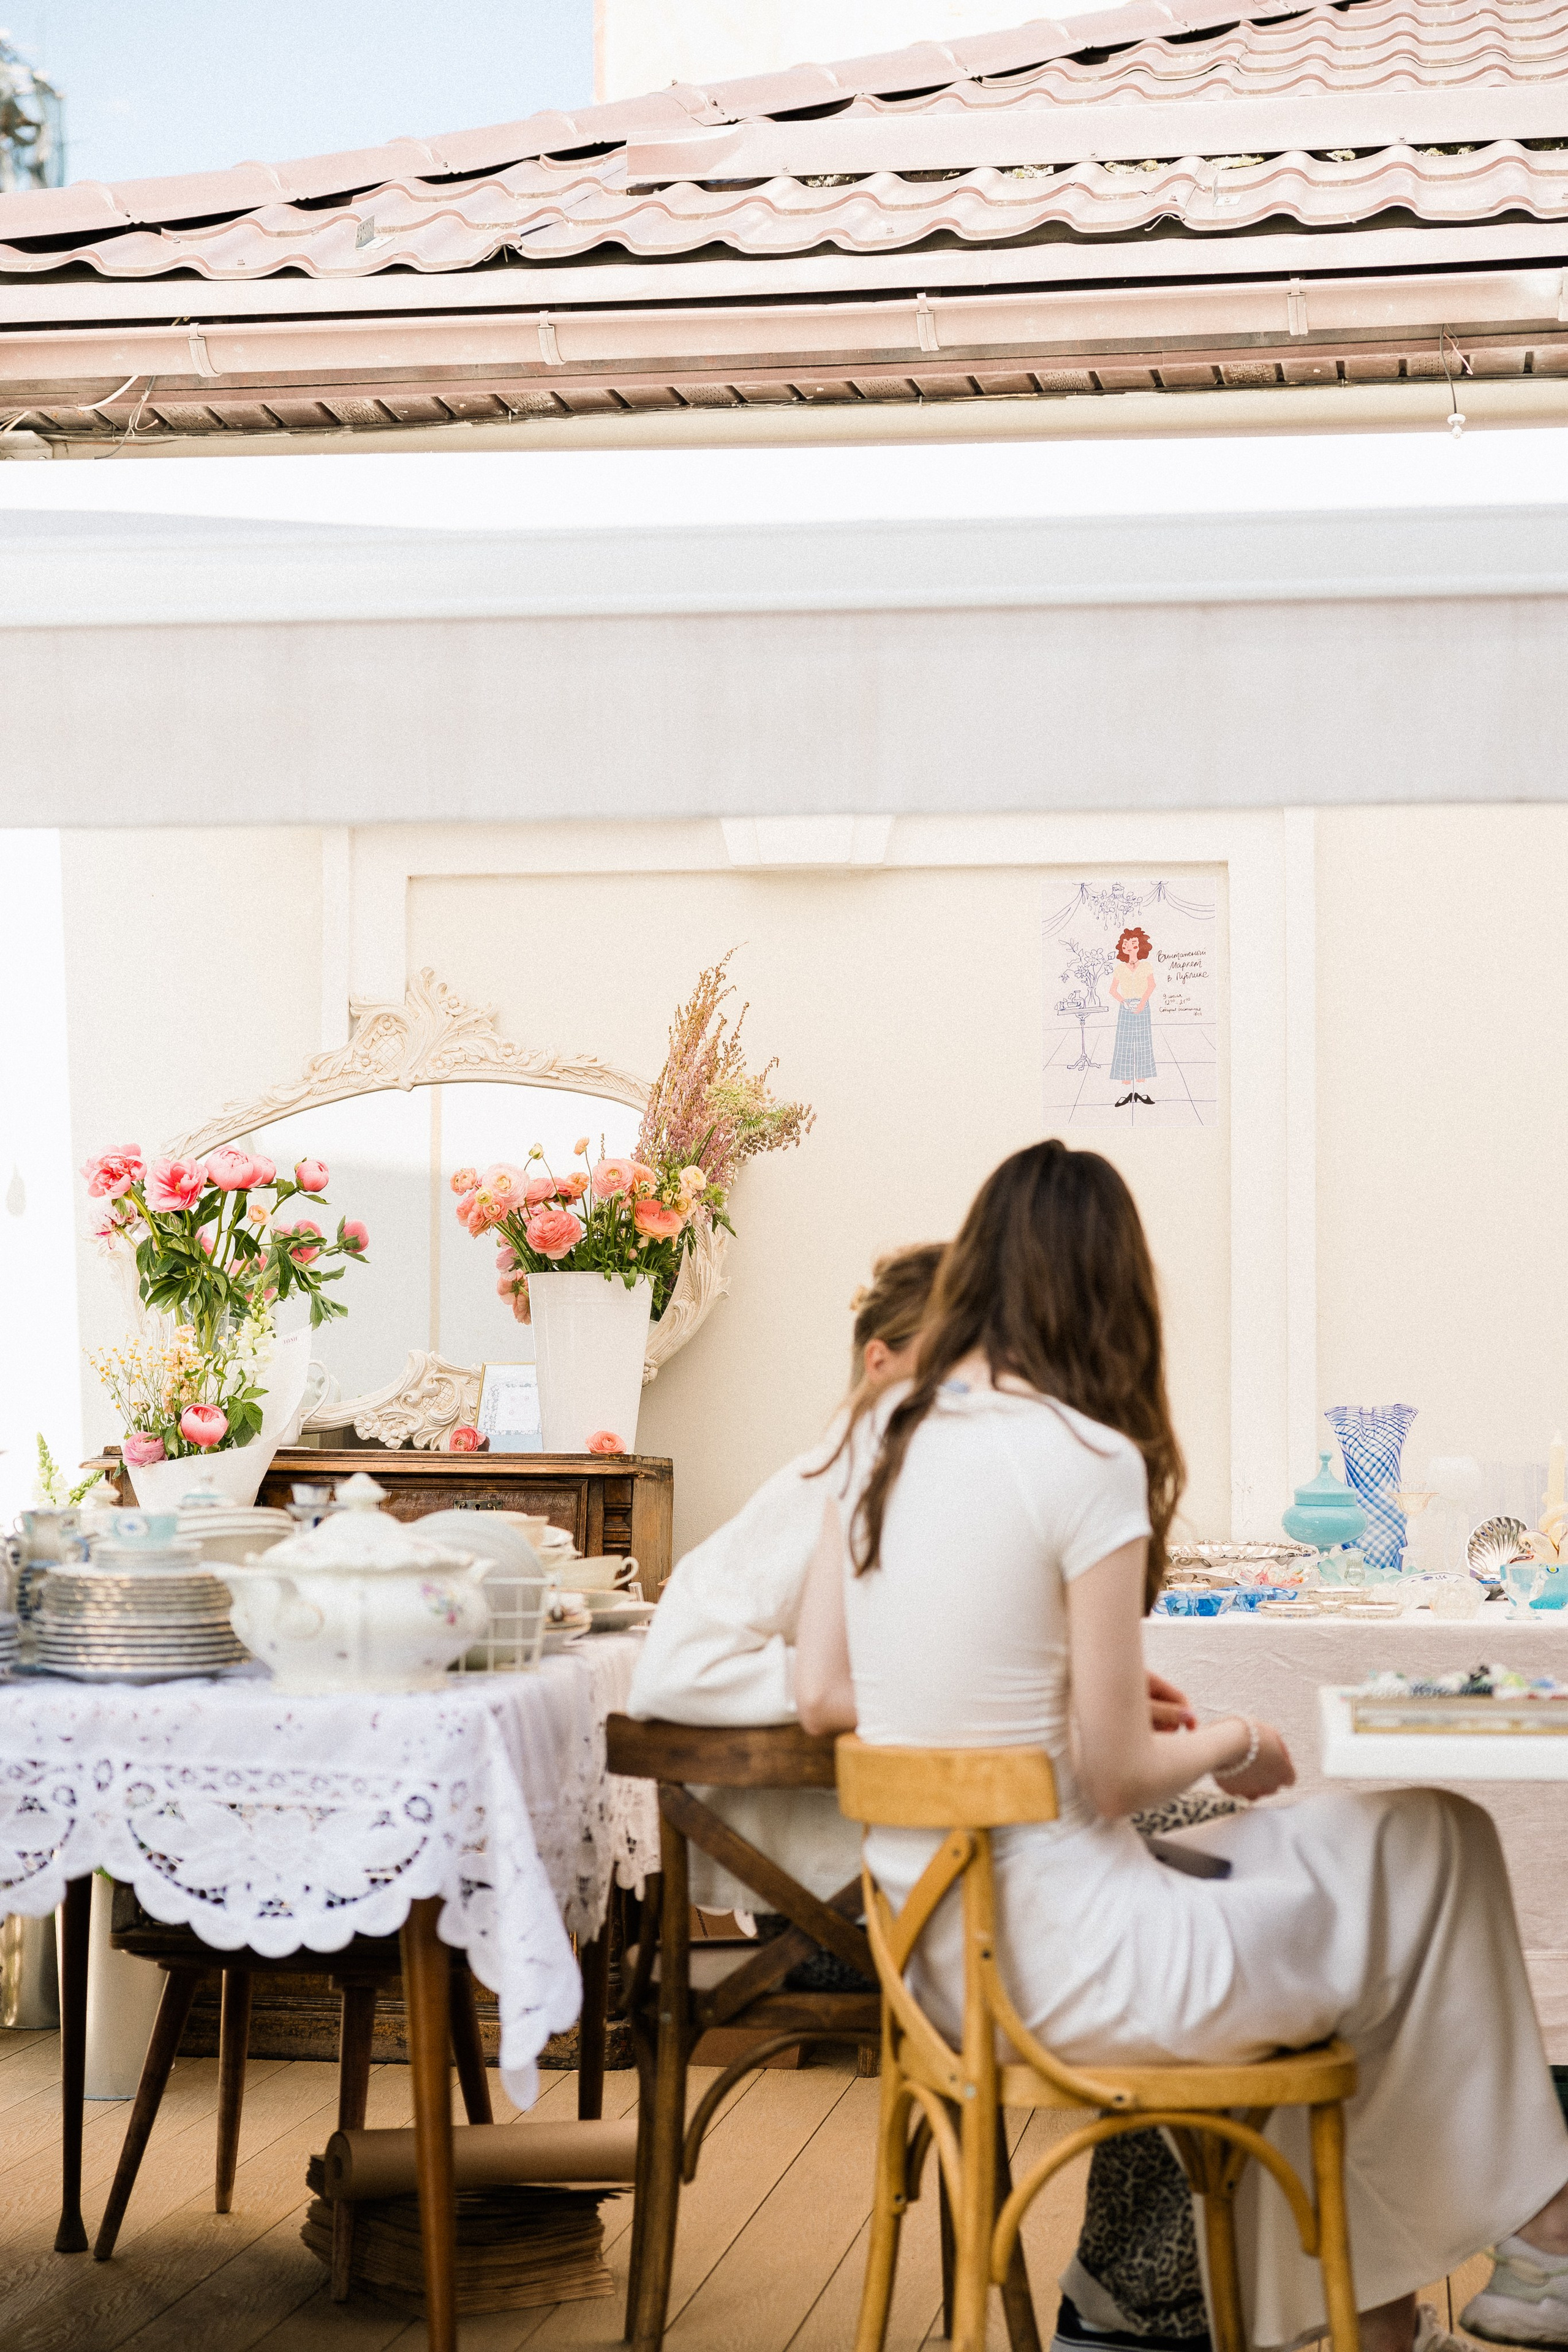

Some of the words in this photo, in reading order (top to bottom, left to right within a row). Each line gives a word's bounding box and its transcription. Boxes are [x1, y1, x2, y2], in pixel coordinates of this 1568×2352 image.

[1156, 948, 1206, 963] Винтажный
[1169, 959, 1202, 971] Маркет
[1177, 971, 1209, 985] Публике
